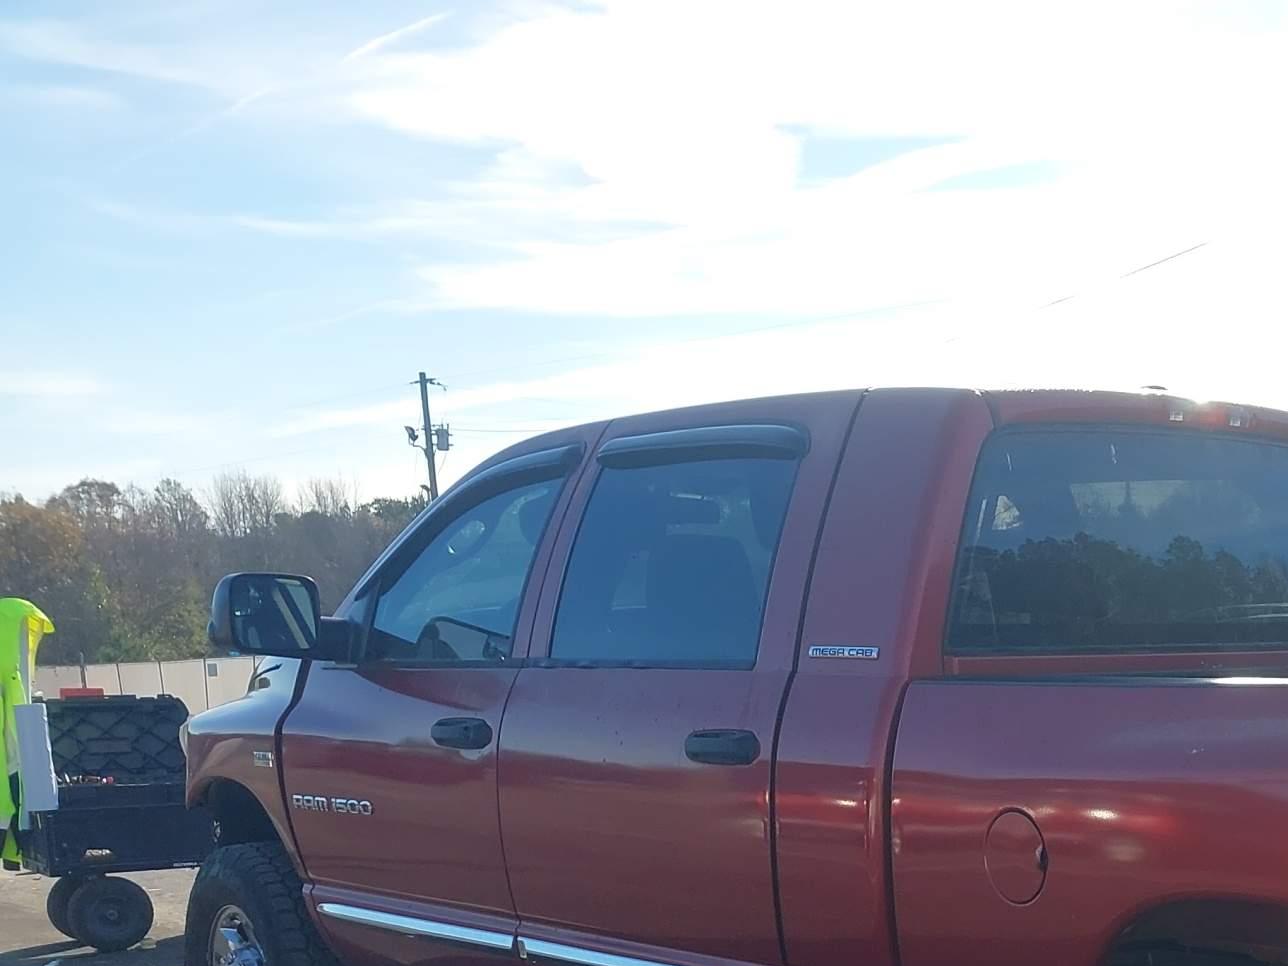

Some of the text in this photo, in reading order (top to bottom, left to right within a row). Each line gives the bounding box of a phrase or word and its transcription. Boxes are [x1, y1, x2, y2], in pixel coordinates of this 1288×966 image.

[811, 647, 874, 657] MEGA CAB
[293, 794, 373, 815] RAM 1500
